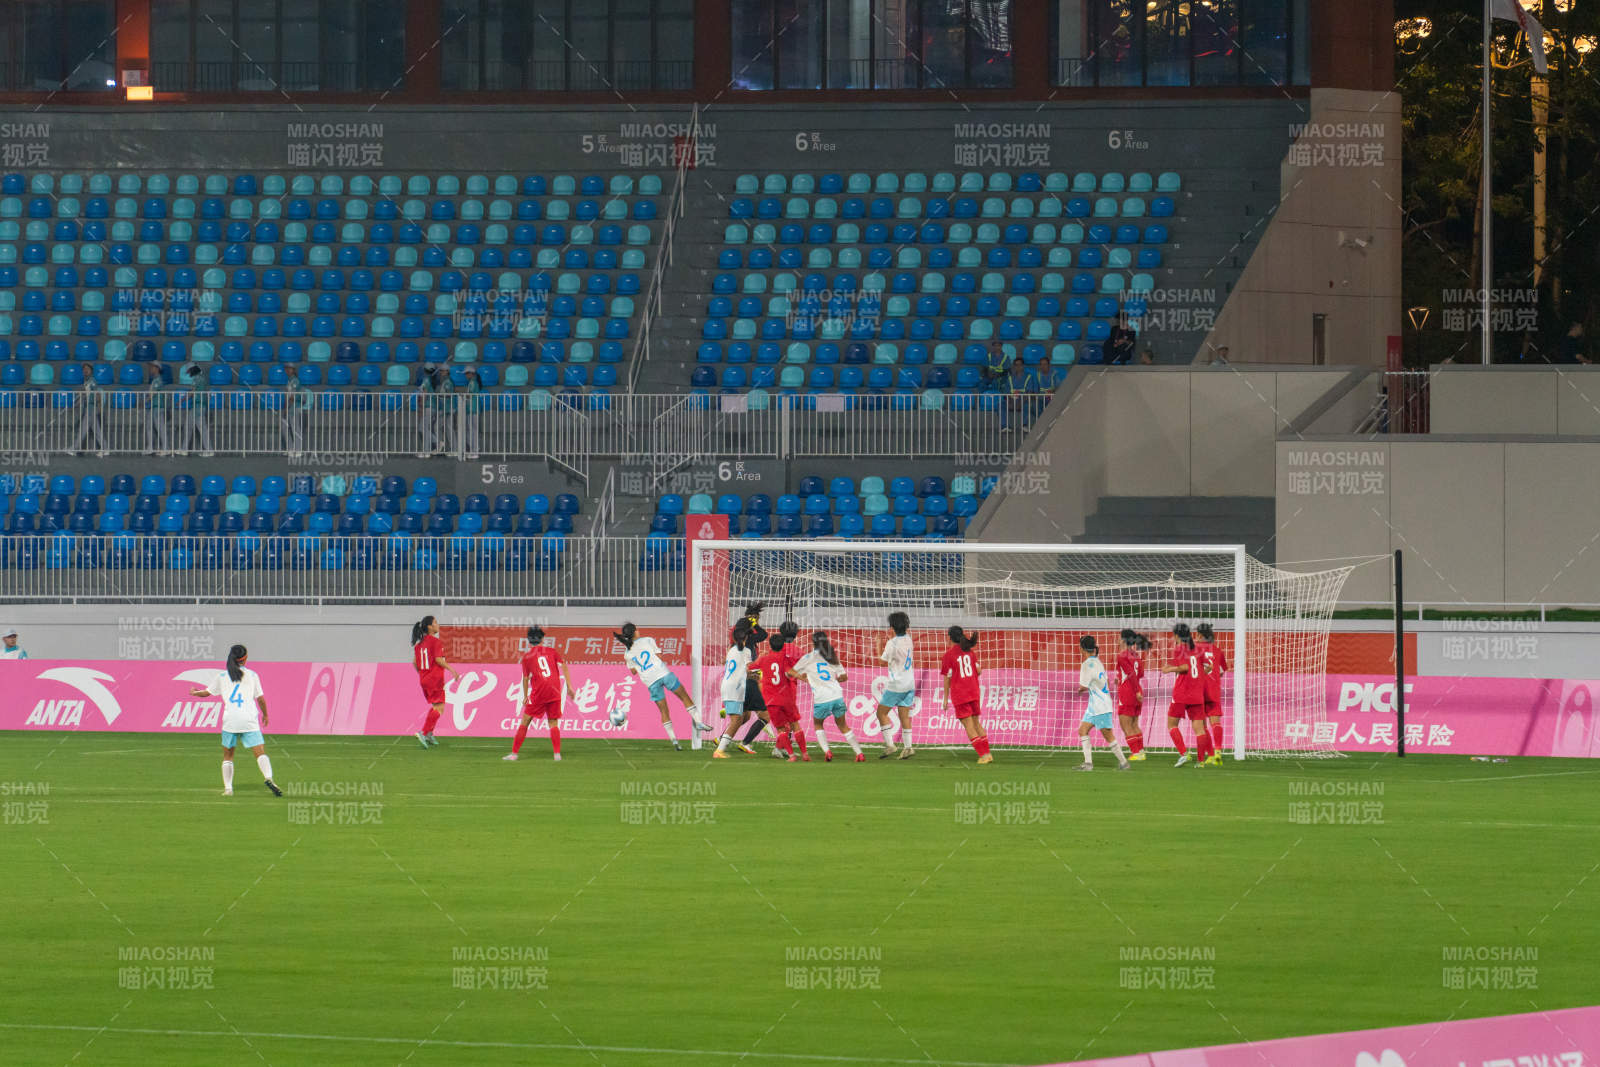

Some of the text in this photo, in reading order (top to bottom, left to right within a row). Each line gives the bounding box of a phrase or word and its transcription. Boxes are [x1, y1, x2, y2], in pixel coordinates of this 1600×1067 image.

[582, 135, 594, 153] 5
[795, 133, 808, 151] 6
[812, 141, 836, 151] Area
[1108, 129, 1134, 149] 6 区
[1125, 140, 1149, 149] Area
[481, 464, 508, 484] 5 区
[498, 474, 524, 484] Area
[718, 462, 745, 481] 6 区
[736, 472, 761, 482] Area
[420, 649, 430, 670] 11
[538, 656, 551, 678] 9
[631, 650, 654, 674] 12
[904, 650, 912, 670] 6
[957, 654, 973, 678] 18
[1190, 655, 1199, 679] 8
[770, 662, 781, 685] 3
[816, 662, 832, 681] 5
[229, 684, 244, 708] 4
[506, 675, 637, 717] 中电信
[933, 685, 1039, 711] 中联通
[1337, 682, 1414, 713] PICC
[25, 700, 86, 726] ANTA
[161, 701, 223, 728] ANTA
[928, 714, 969, 730] Chin
[501, 718, 550, 730] CHNA
[1285, 720, 1455, 746] 中国人民保险
